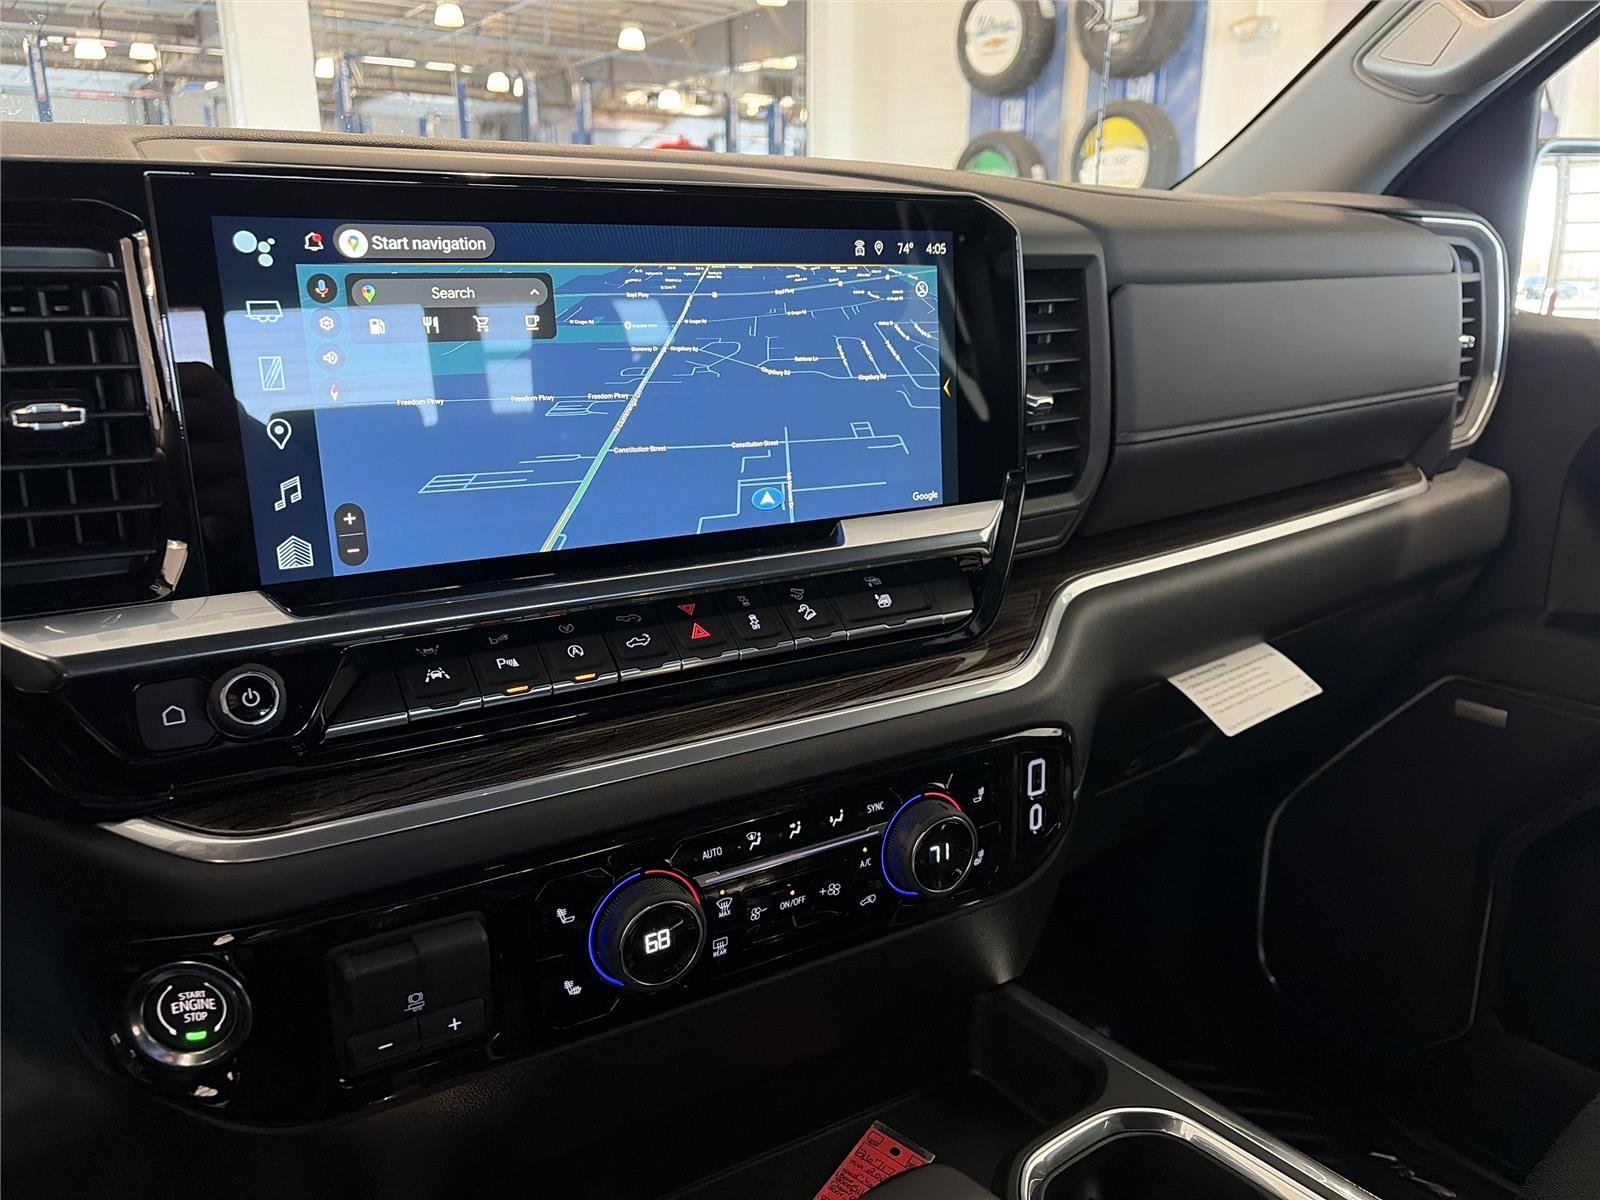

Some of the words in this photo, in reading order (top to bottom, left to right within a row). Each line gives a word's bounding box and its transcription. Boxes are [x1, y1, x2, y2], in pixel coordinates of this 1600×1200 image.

[372, 236, 410, 250] Start
[412, 236, 486, 253] navigation
[925, 242, 947, 255] 4:05
[431, 286, 476, 299] Search
[396, 398, 426, 406] Freedom
[426, 398, 445, 406] Pkwy
[535, 394, 555, 402] Pkwy
[607, 392, 629, 401] Pkwy
[731, 441, 763, 449] Constitution
[912, 490, 938, 502] Google
[867, 801, 885, 814] SYNC
[702, 846, 723, 861] AUTO
[930, 842, 950, 863] 71
[859, 857, 872, 869] A/C
[779, 894, 806, 911] ON/OFF
[718, 908, 731, 918] MAX
[644, 928, 671, 954] 68
[712, 948, 727, 958] REAR
[178, 990, 206, 1001] START
[170, 998, 217, 1015] ENGINE
[183, 1011, 208, 1024] STOP
